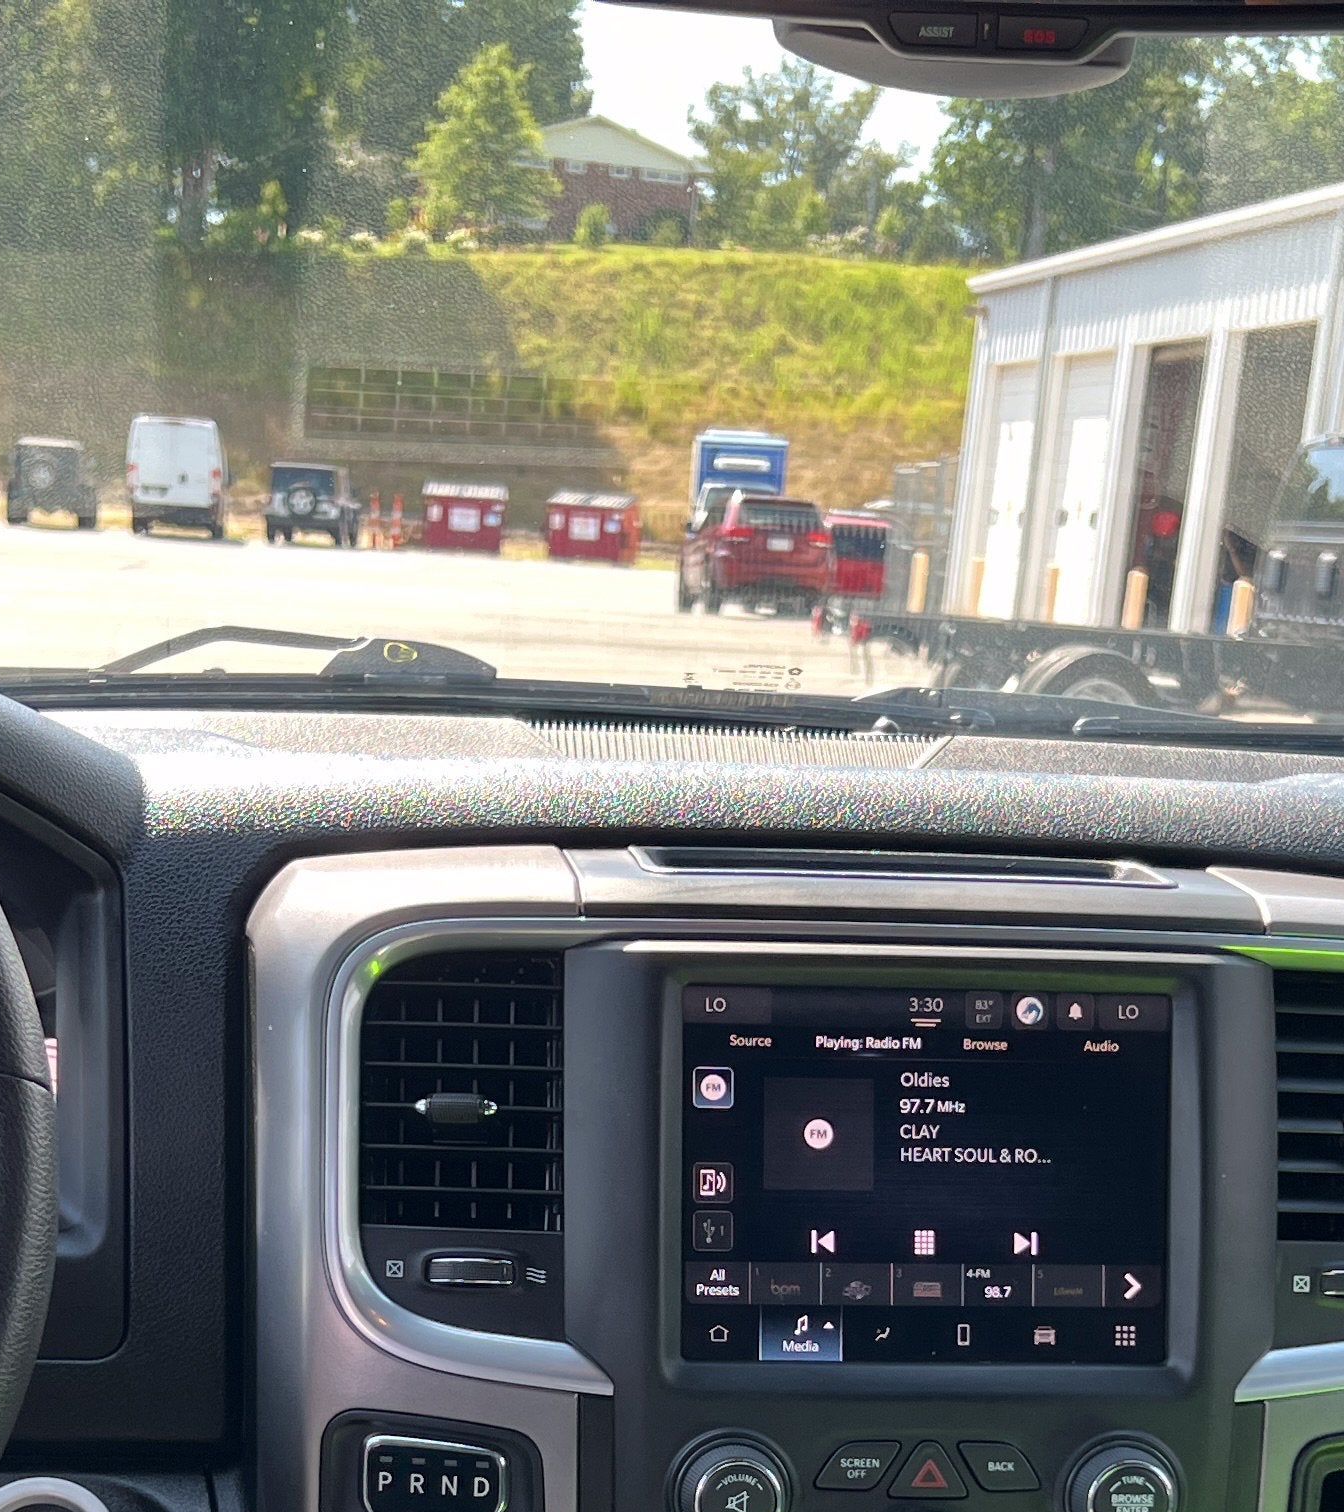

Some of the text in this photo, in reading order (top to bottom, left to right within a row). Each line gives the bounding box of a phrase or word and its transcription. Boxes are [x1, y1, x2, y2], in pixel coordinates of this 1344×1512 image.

[919, 26, 955, 38] ASSIST
[705, 997, 727, 1012] LO
[908, 997, 943, 1013] 3:30
[1118, 1004, 1139, 1020] LO
[729, 1034, 773, 1047] Source
[815, 1036, 922, 1051] Playing: Radio FM
[963, 1038, 1009, 1051] Browse
[1083, 1039, 1120, 1053] Audio
[900, 1072, 950, 1088] Oldies
[705, 1083, 721, 1093] FM
[899, 1099, 966, 1114] 97.7 MHz
[809, 1129, 828, 1140] FM
[899, 1124, 941, 1140] CLAY
[900, 1147, 1052, 1164] HEART SOUL & RO...
[709, 1268, 726, 1282] All
[825, 1268, 832, 1278] 2
[695, 1282, 740, 1297] Presets
[984, 1285, 1012, 1298] 98.7
[782, 1339, 820, 1353] Media
[840, 1457, 880, 1469] SCREEN
[988, 1461, 1015, 1472] BACK
[721, 1473, 757, 1486] VOLUME
[847, 1469, 867, 1479] OFF
[1121, 1475, 1146, 1486] TUNE
[378, 1471, 490, 1497] P R N D
[1111, 1493, 1154, 1504] BROWSE
